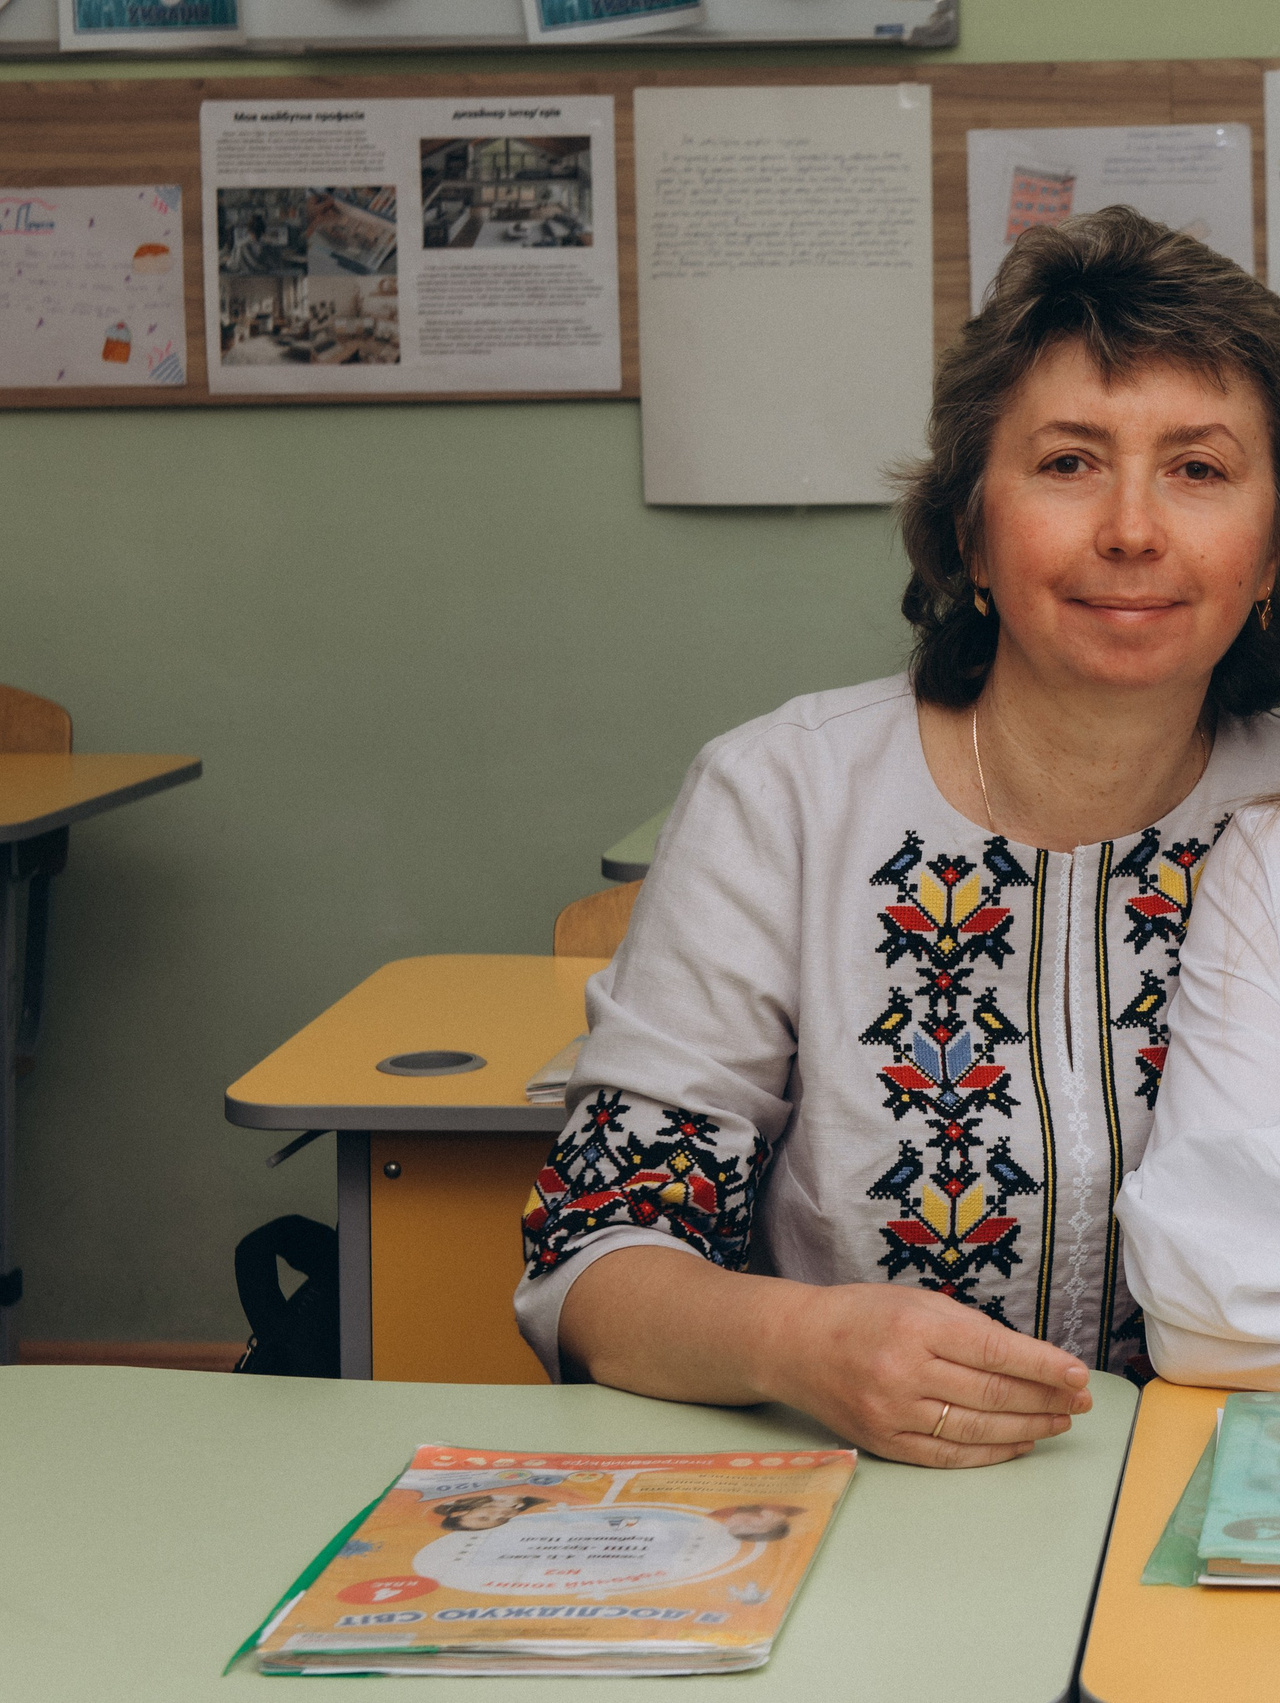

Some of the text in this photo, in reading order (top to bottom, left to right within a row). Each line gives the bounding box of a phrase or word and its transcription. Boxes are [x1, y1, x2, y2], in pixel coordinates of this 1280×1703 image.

[436, 1481, 482, 1493] 120
[337, 1611, 424, 1627] СВІТ
[437, 1606, 691, 1622] ДОСЛІДЖУЮ
